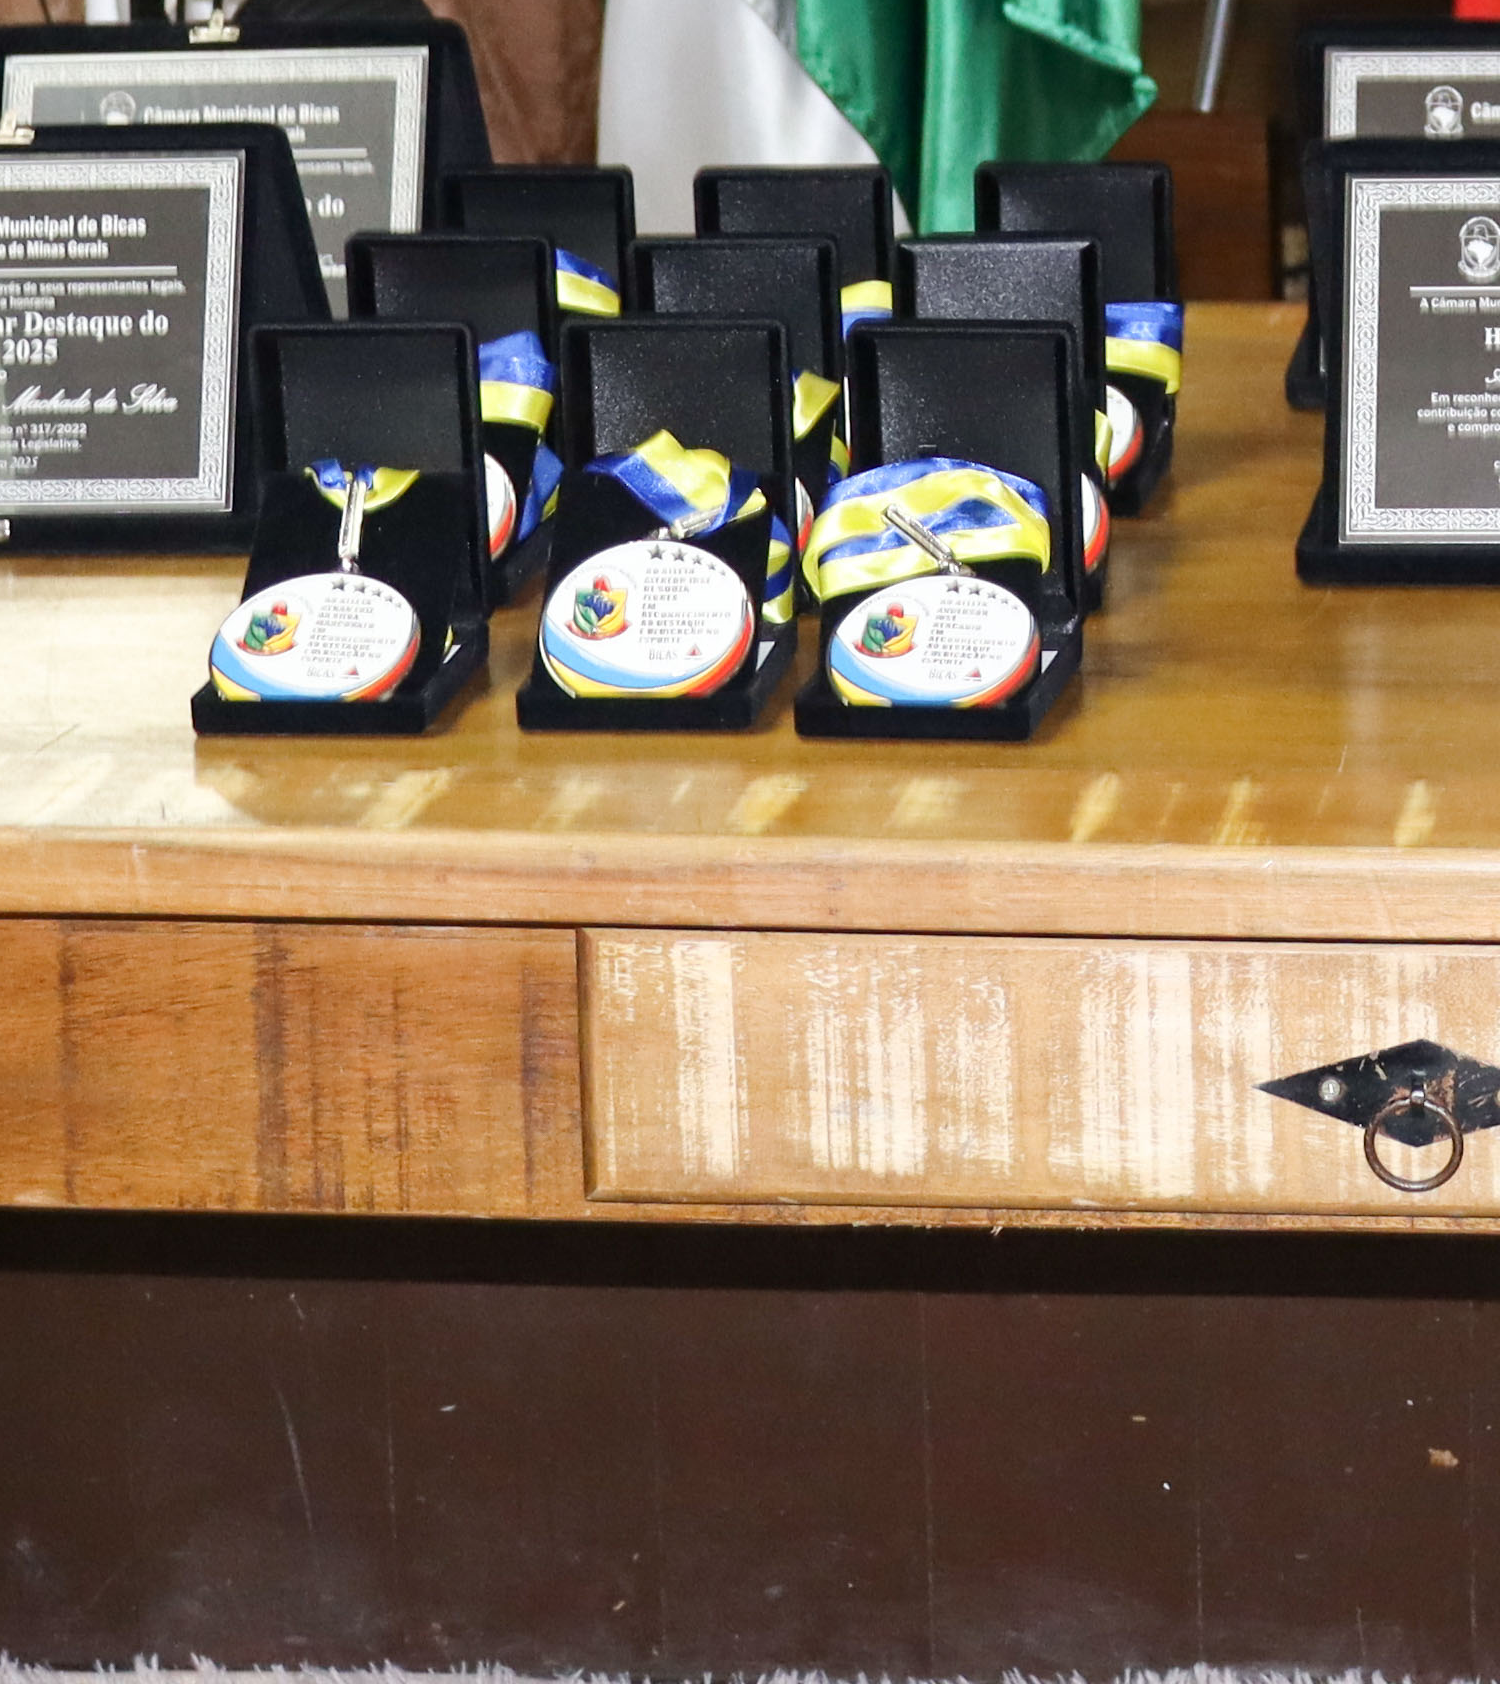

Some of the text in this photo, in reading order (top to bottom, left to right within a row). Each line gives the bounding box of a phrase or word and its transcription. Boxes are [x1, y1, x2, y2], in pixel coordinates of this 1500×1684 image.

[203, 105, 275, 123] Municipal
[278, 106, 296, 123] de
[299, 104, 340, 123] Bicas
[78, 216, 97, 236] de
[102, 215, 146, 235] Bicas
[9, 242, 24, 257] de
[27, 241, 65, 257] Minas
[68, 240, 108, 257] Gerais
[25, 311, 132, 340] Destaque
[140, 310, 168, 334] do
[2, 339, 58, 362] 2025
[1431, 393, 1449, 402] Em
[1418, 407, 1488, 418] contribuição
